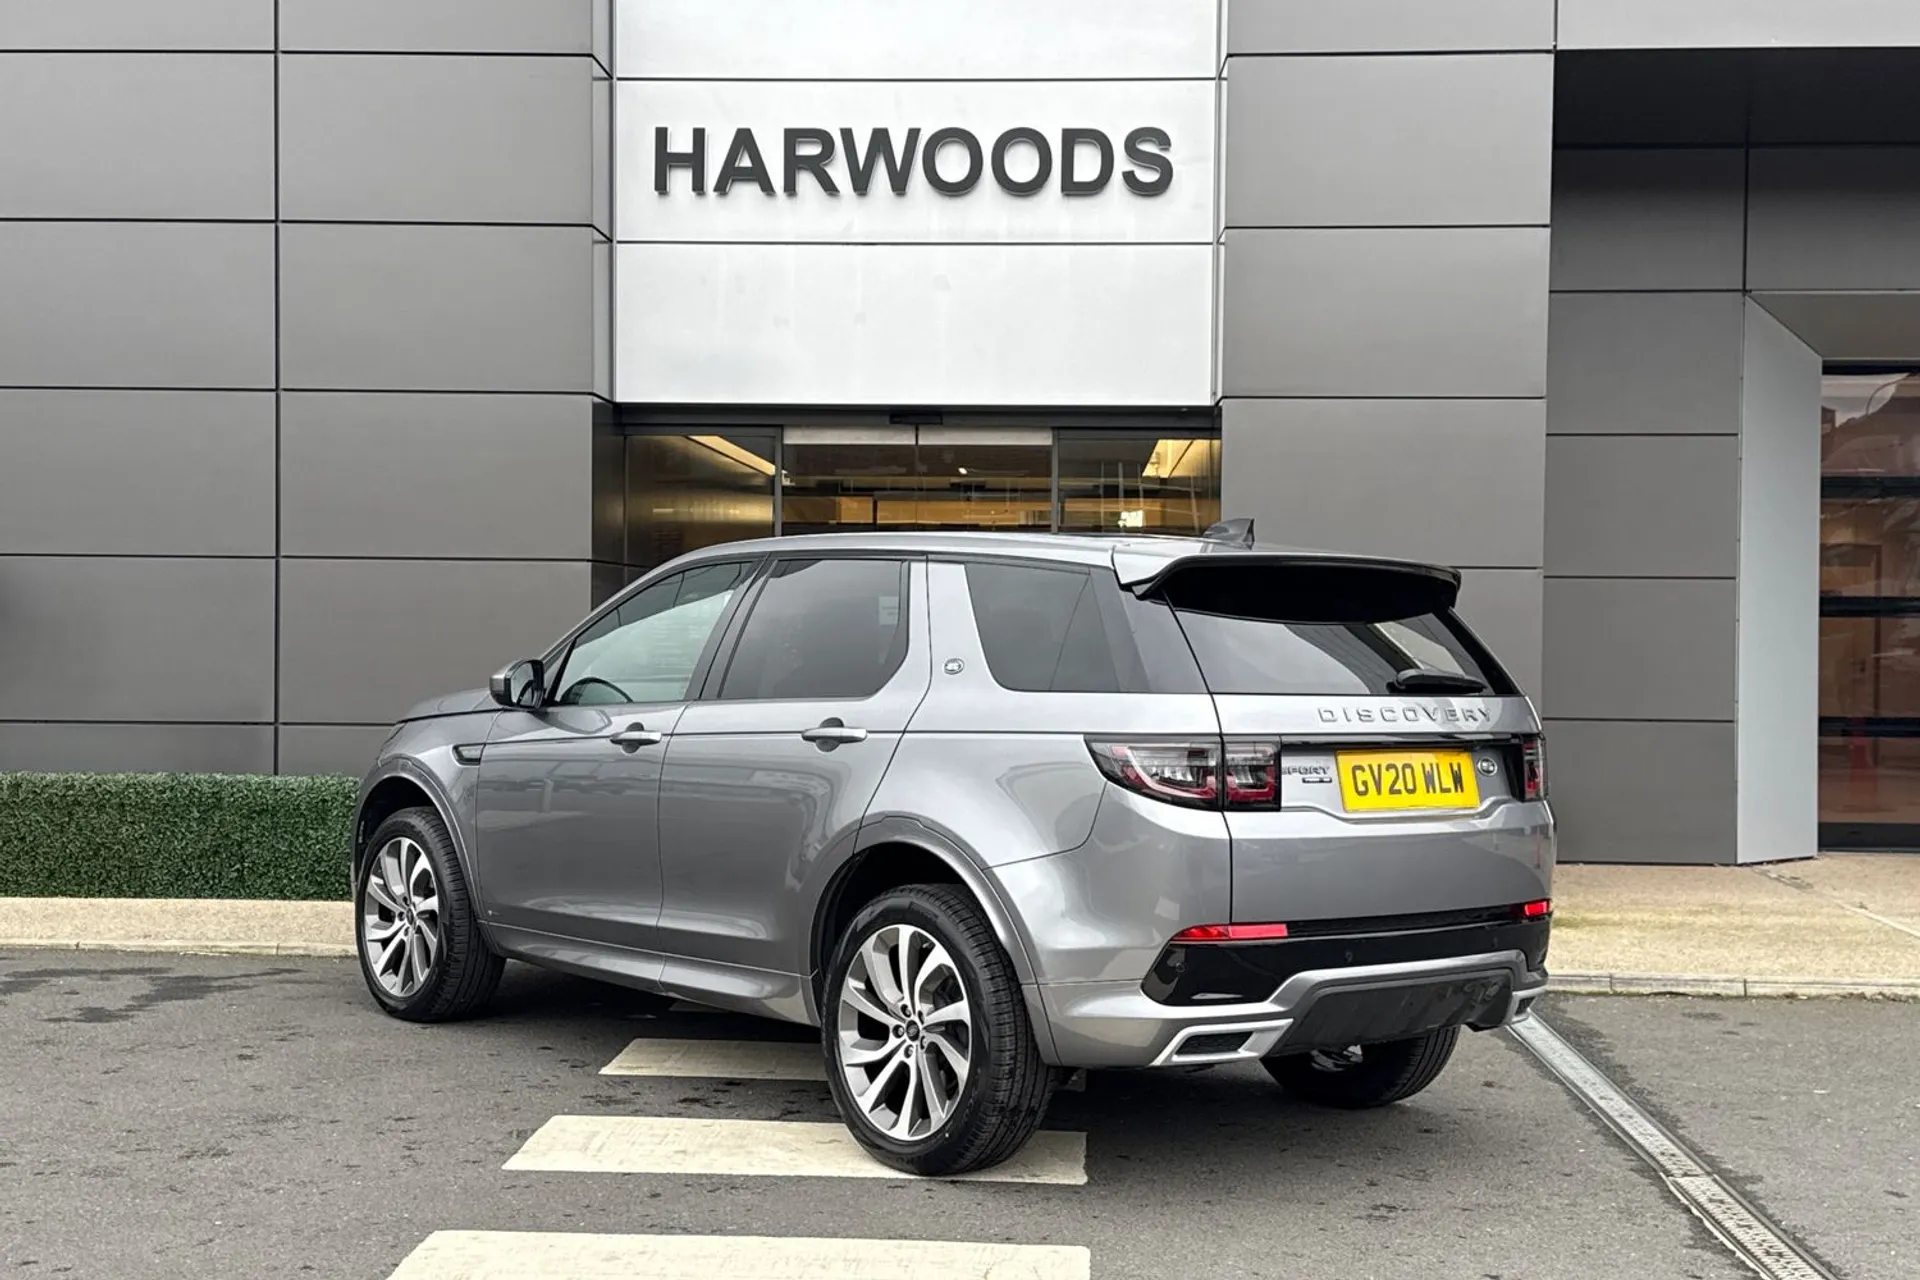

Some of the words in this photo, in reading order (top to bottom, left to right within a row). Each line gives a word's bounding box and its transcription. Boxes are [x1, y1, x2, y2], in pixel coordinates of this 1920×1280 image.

[654, 126, 1174, 196] HARWOODS
[1317, 706, 1491, 723] DISCOVERY
[1351, 763, 1417, 796] GV20
[1421, 762, 1464, 794] WLW
